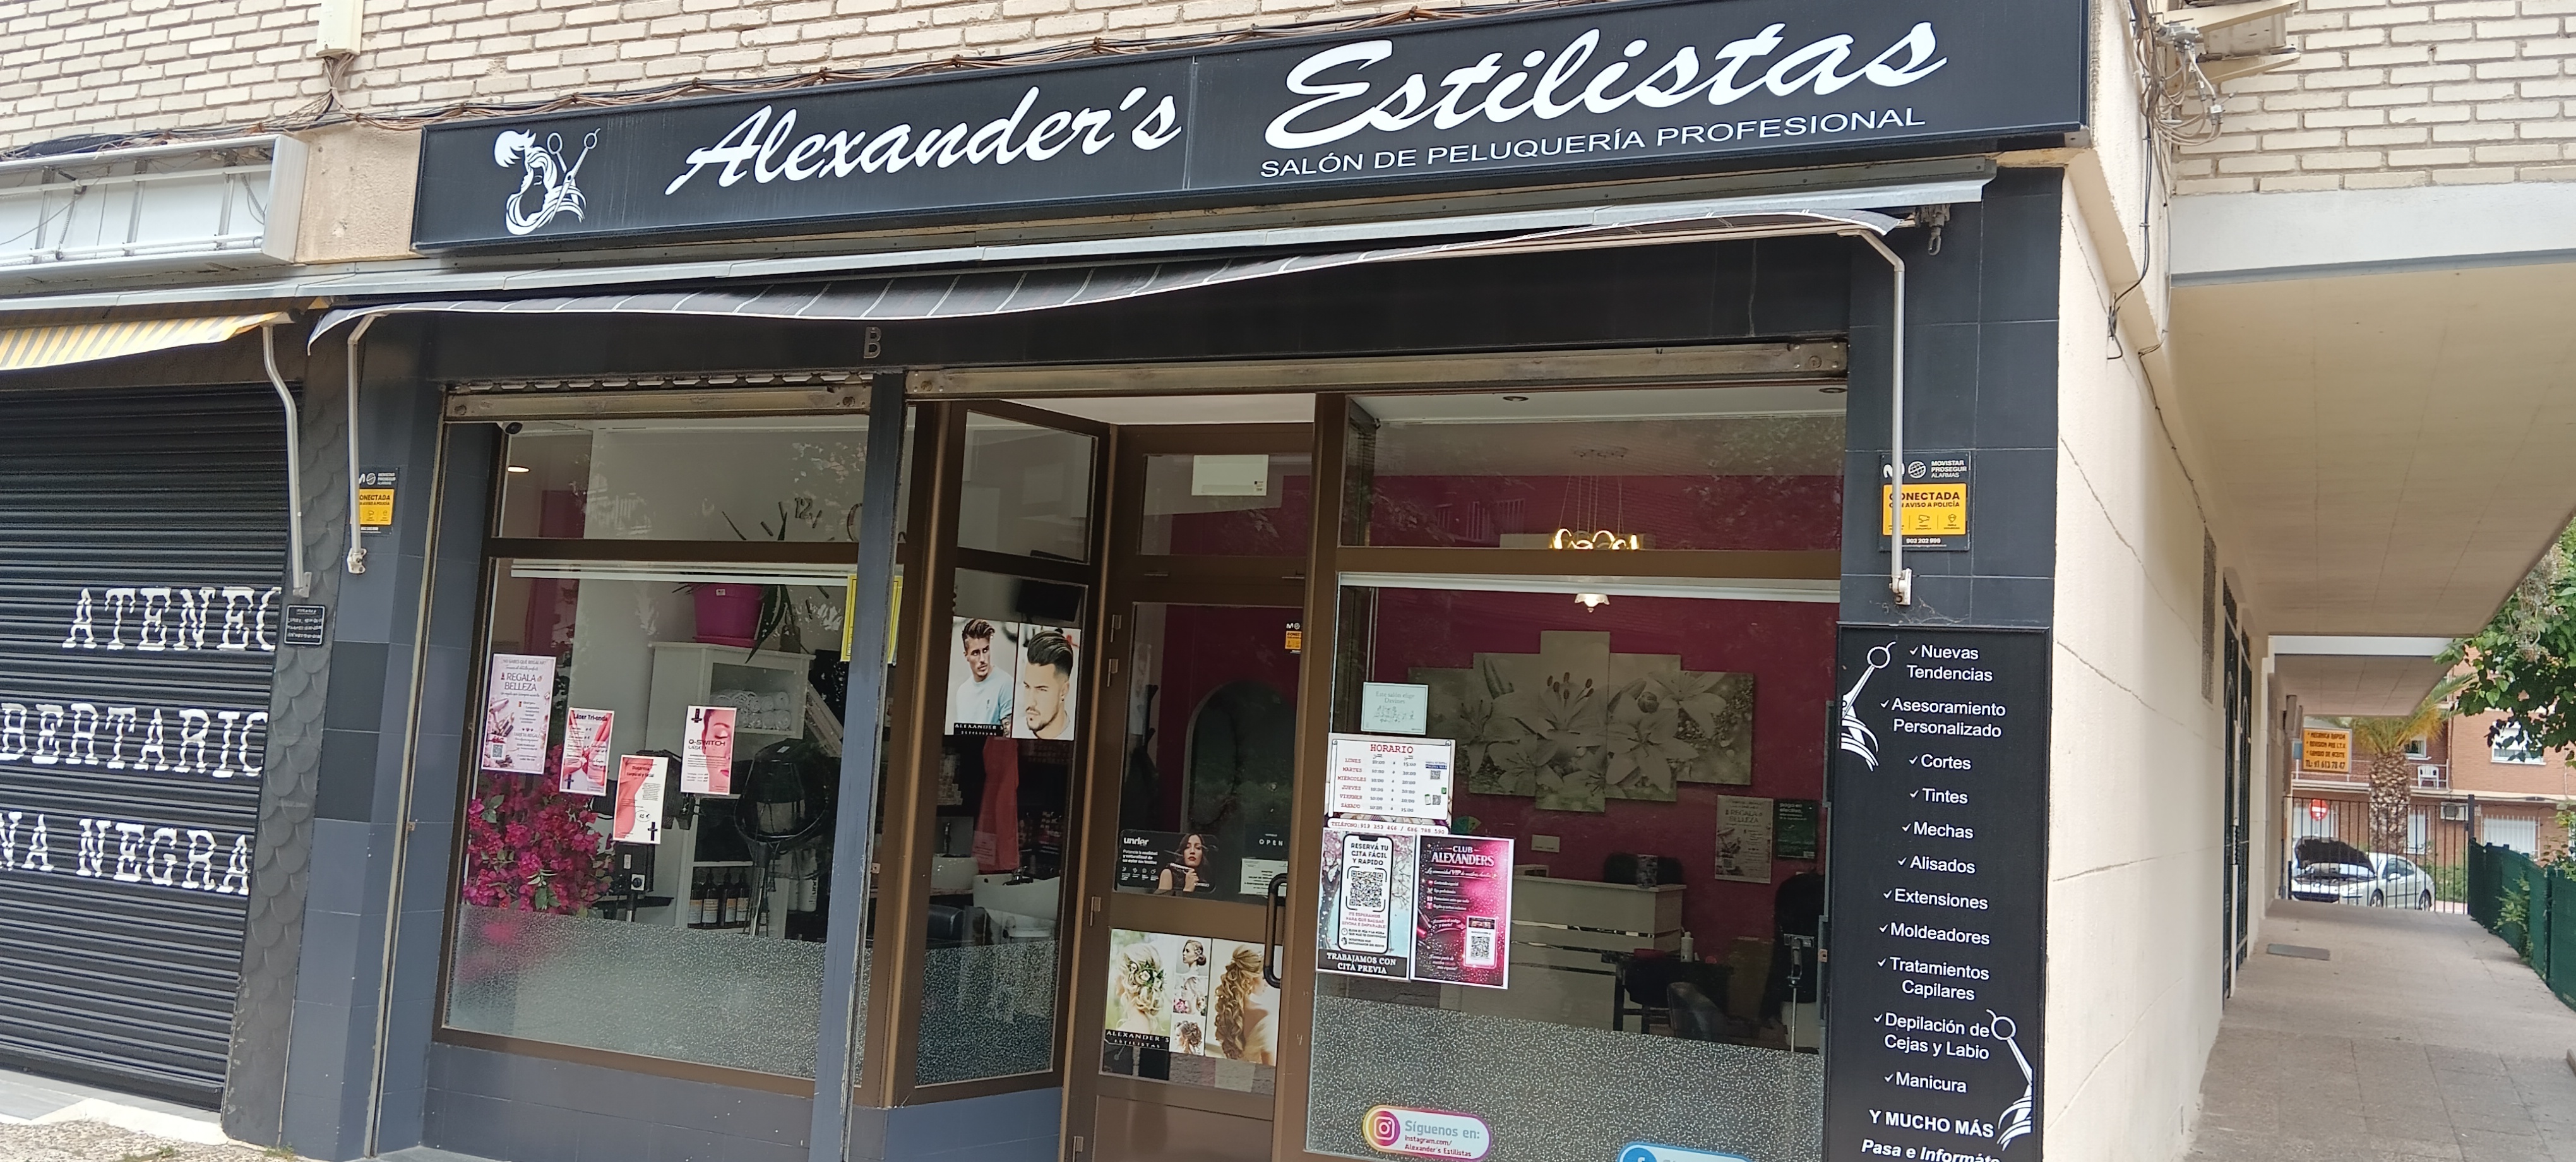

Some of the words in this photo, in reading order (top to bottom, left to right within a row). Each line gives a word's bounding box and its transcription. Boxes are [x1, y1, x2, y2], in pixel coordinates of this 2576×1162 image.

[1264, 22, 1947, 148] Estilistas
[1260, 152, 1363, 178] SALÓN
[1375, 148, 1416, 169] DE
[1428, 128, 1645, 165] PELUQUERÍA
[1657, 107, 1925, 147] PROFESIONAL
[864, 327, 881, 358] B
[1921, 645, 1979, 660] Nuevas
[506, 673, 536, 682] REGALA
[1907, 665, 1993, 681] Tendencias
[504, 682, 537, 691] BELLEZA
[1892, 698, 2006, 716] Asesoramiento
[1894, 719, 2001, 737] Personalizado
[1370, 744, 1414, 753] HORARIO
[1921, 754, 1971, 770] Cortes
[1923, 788, 1968, 804] Tintes
[1914, 822, 1973, 839] Mechas
[1123, 837, 1149, 845] under
[76, 817, 251, 895] NEGRA
[1368, 850, 1387, 859] FÁCIL
[1431, 852, 1494, 866] ALEXANDERS
[1910, 856, 1976, 873] Alisados
[1895, 889, 1988, 909] Extensiones
[1891, 923, 1990, 945] Moldeadores
[1327, 952, 1377, 964] TRABAJAMOS
[1379, 957, 1396, 966] CON
[1357, 964, 1386, 974] PREVIA
[1890, 957, 1989, 980] Tratamientos
[1902, 980, 1975, 1000] Capilares
[1885, 1013, 1965, 1034] Depilación
[1969, 1023, 1989, 1038] de
[1885, 1034, 1928, 1053] Cejas
[1933, 1043, 1942, 1057] y
[1947, 1041, 1989, 1059] Labio
[1896, 1072, 1967, 1093] Manicura
[1405, 1120, 1458, 1137] Síguenos
[1462, 1129, 1480, 1139] en:
[1869, 1110, 1881, 1123] Y
[1885, 1111, 1950, 1132] MUCHO
[1955, 1119, 1995, 1137] MÁS
[1443, 1147, 1472, 1157] Estilistas
[1861, 1139, 1902, 1156] Pasa
[1906, 1147, 1916, 1158] e
[1920, 1147, 2000, 1162] Informát
